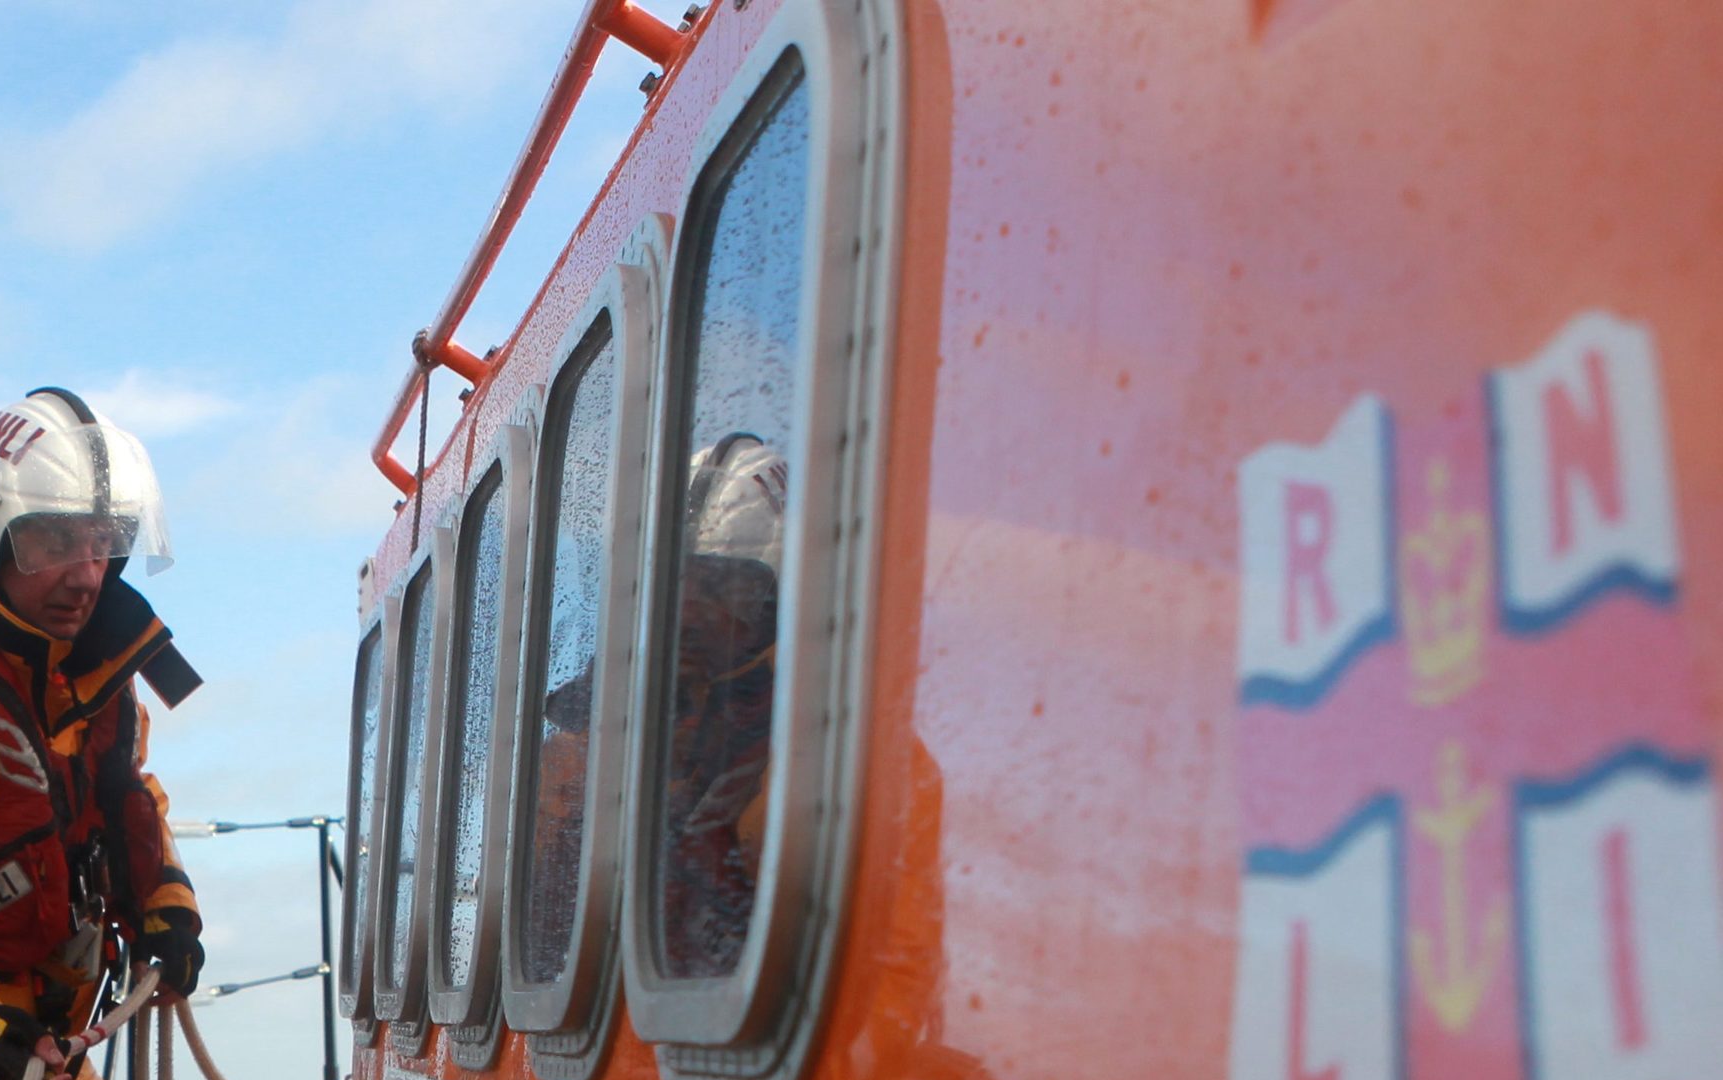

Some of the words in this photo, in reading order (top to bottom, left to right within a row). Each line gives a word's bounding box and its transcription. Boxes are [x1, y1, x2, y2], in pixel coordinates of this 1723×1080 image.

[1284, 480, 1339, 646] R
[1542, 345, 1624, 559] N
[1599, 824, 1650, 1053] I
